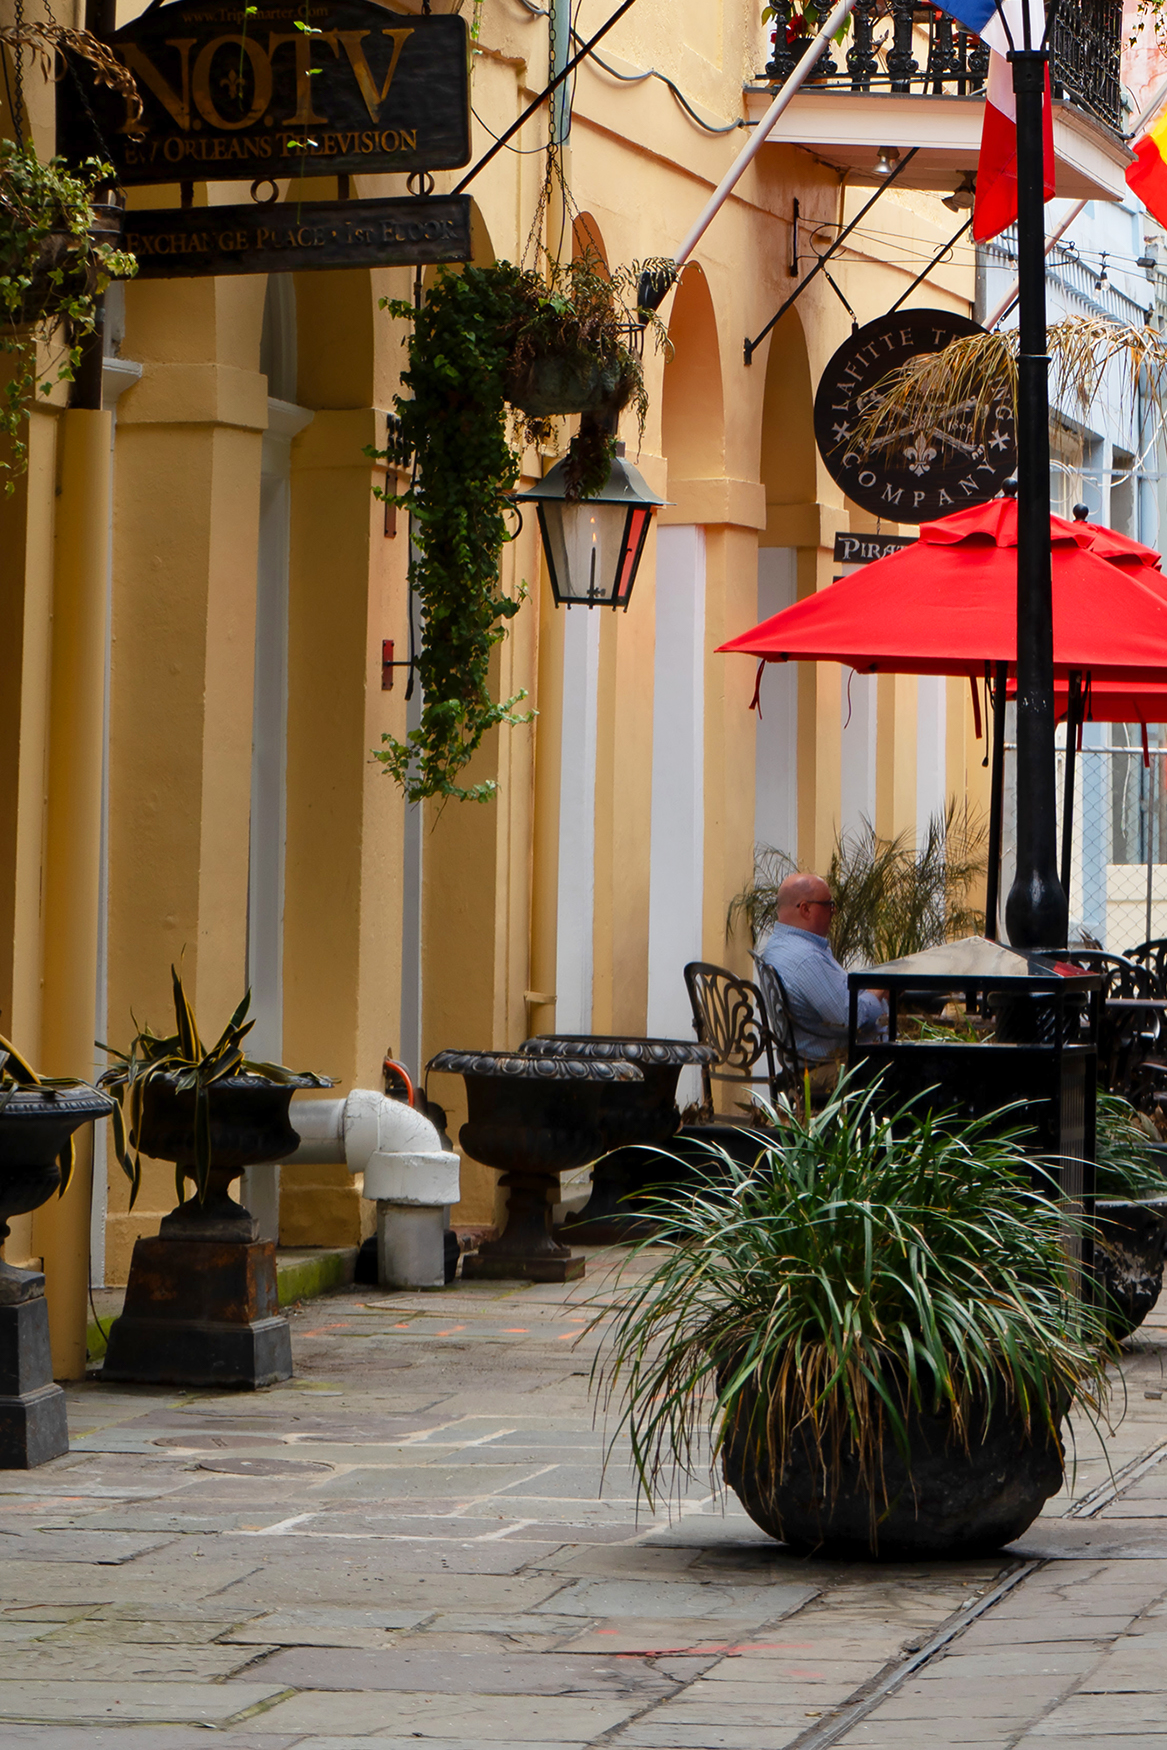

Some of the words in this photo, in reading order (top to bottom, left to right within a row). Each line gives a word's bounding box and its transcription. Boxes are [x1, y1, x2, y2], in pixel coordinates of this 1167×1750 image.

[163, 134, 273, 164] ORLEANS
[275, 128, 419, 159] TELEVISION
[831, 327, 915, 411] LAFITTE
[842, 451, 997, 508] COMPANY
